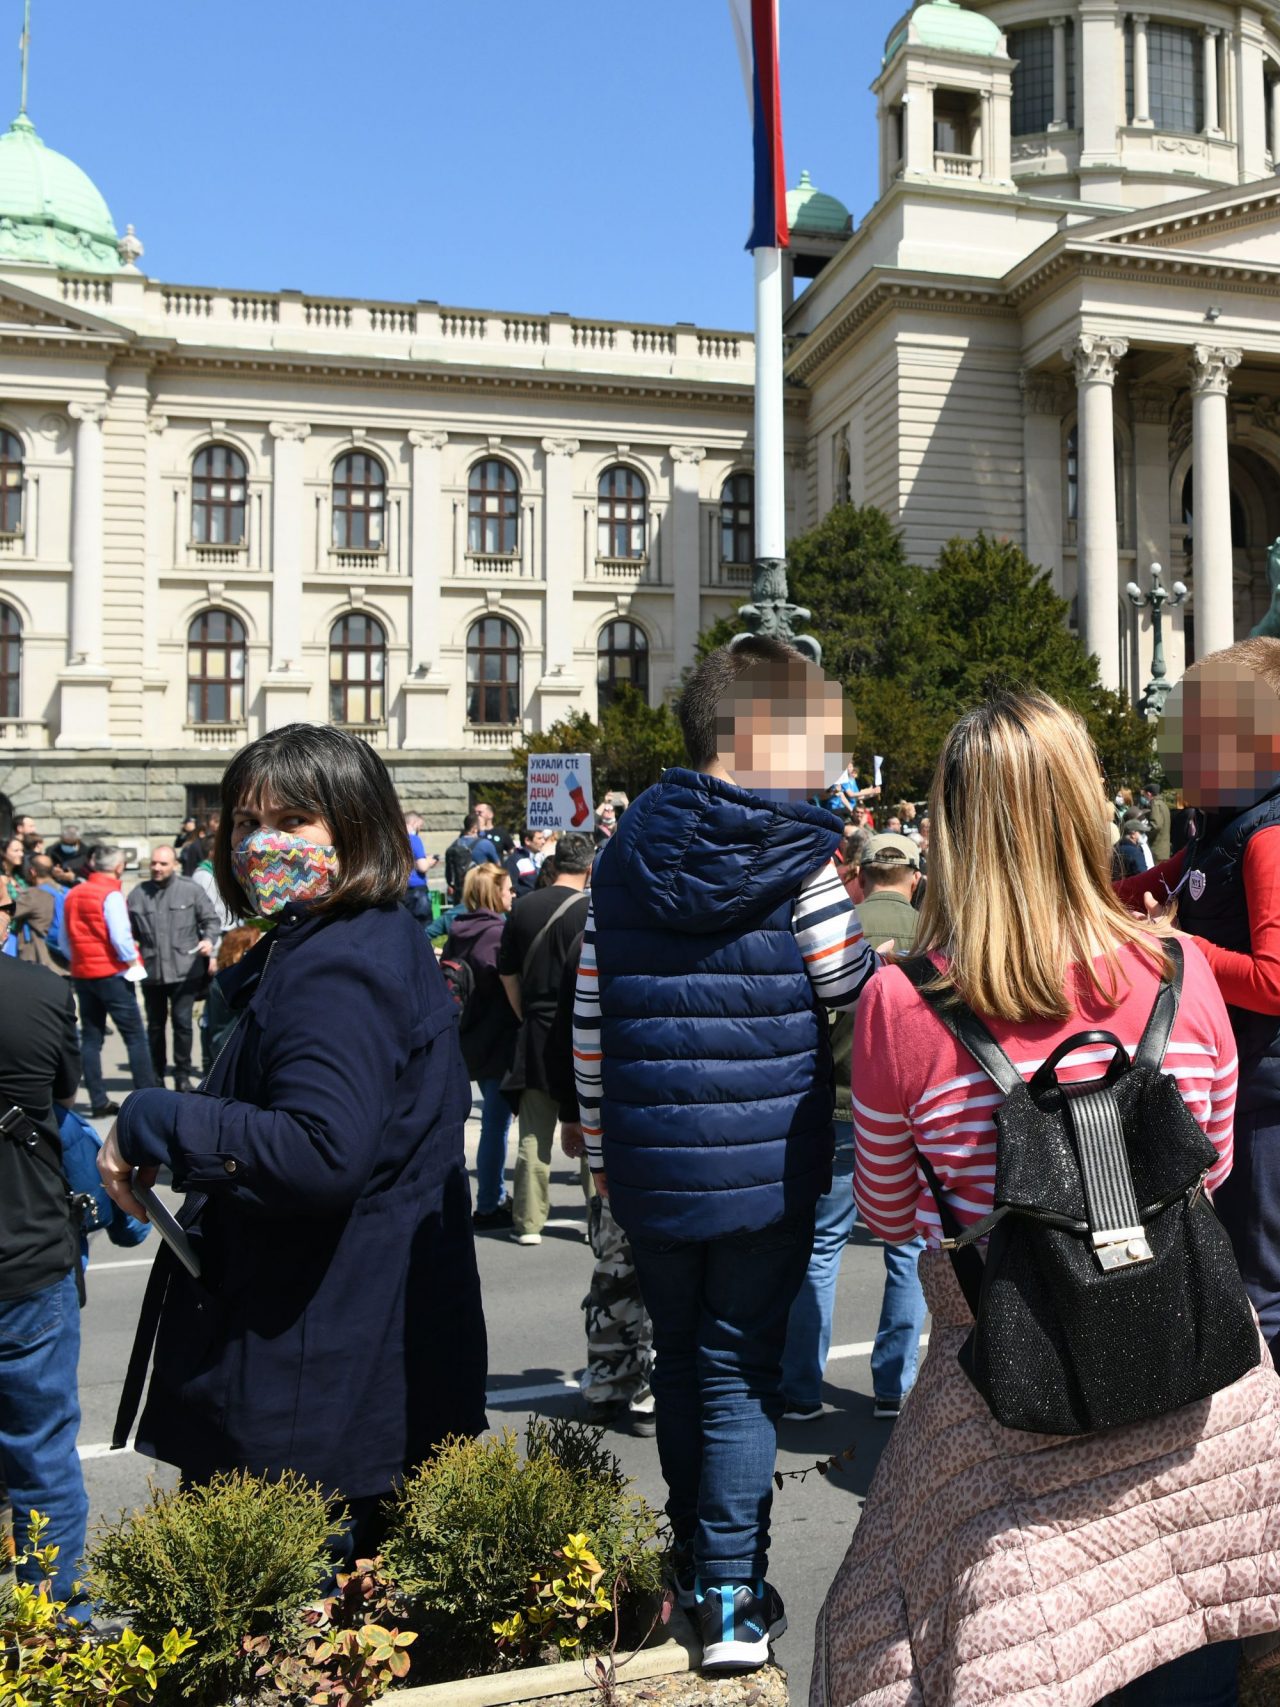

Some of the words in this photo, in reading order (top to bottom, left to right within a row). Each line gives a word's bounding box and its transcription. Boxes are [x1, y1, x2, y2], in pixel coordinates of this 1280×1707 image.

[531, 759, 563, 769] УКРАЛИ
[565, 759, 579, 769] СТЕ
[531, 773, 559, 786] НАШОЈ
[530, 788, 554, 800] ДЕЦИ
[530, 802, 553, 814] ДЕДА
[530, 816, 562, 827] МРАЗА!
